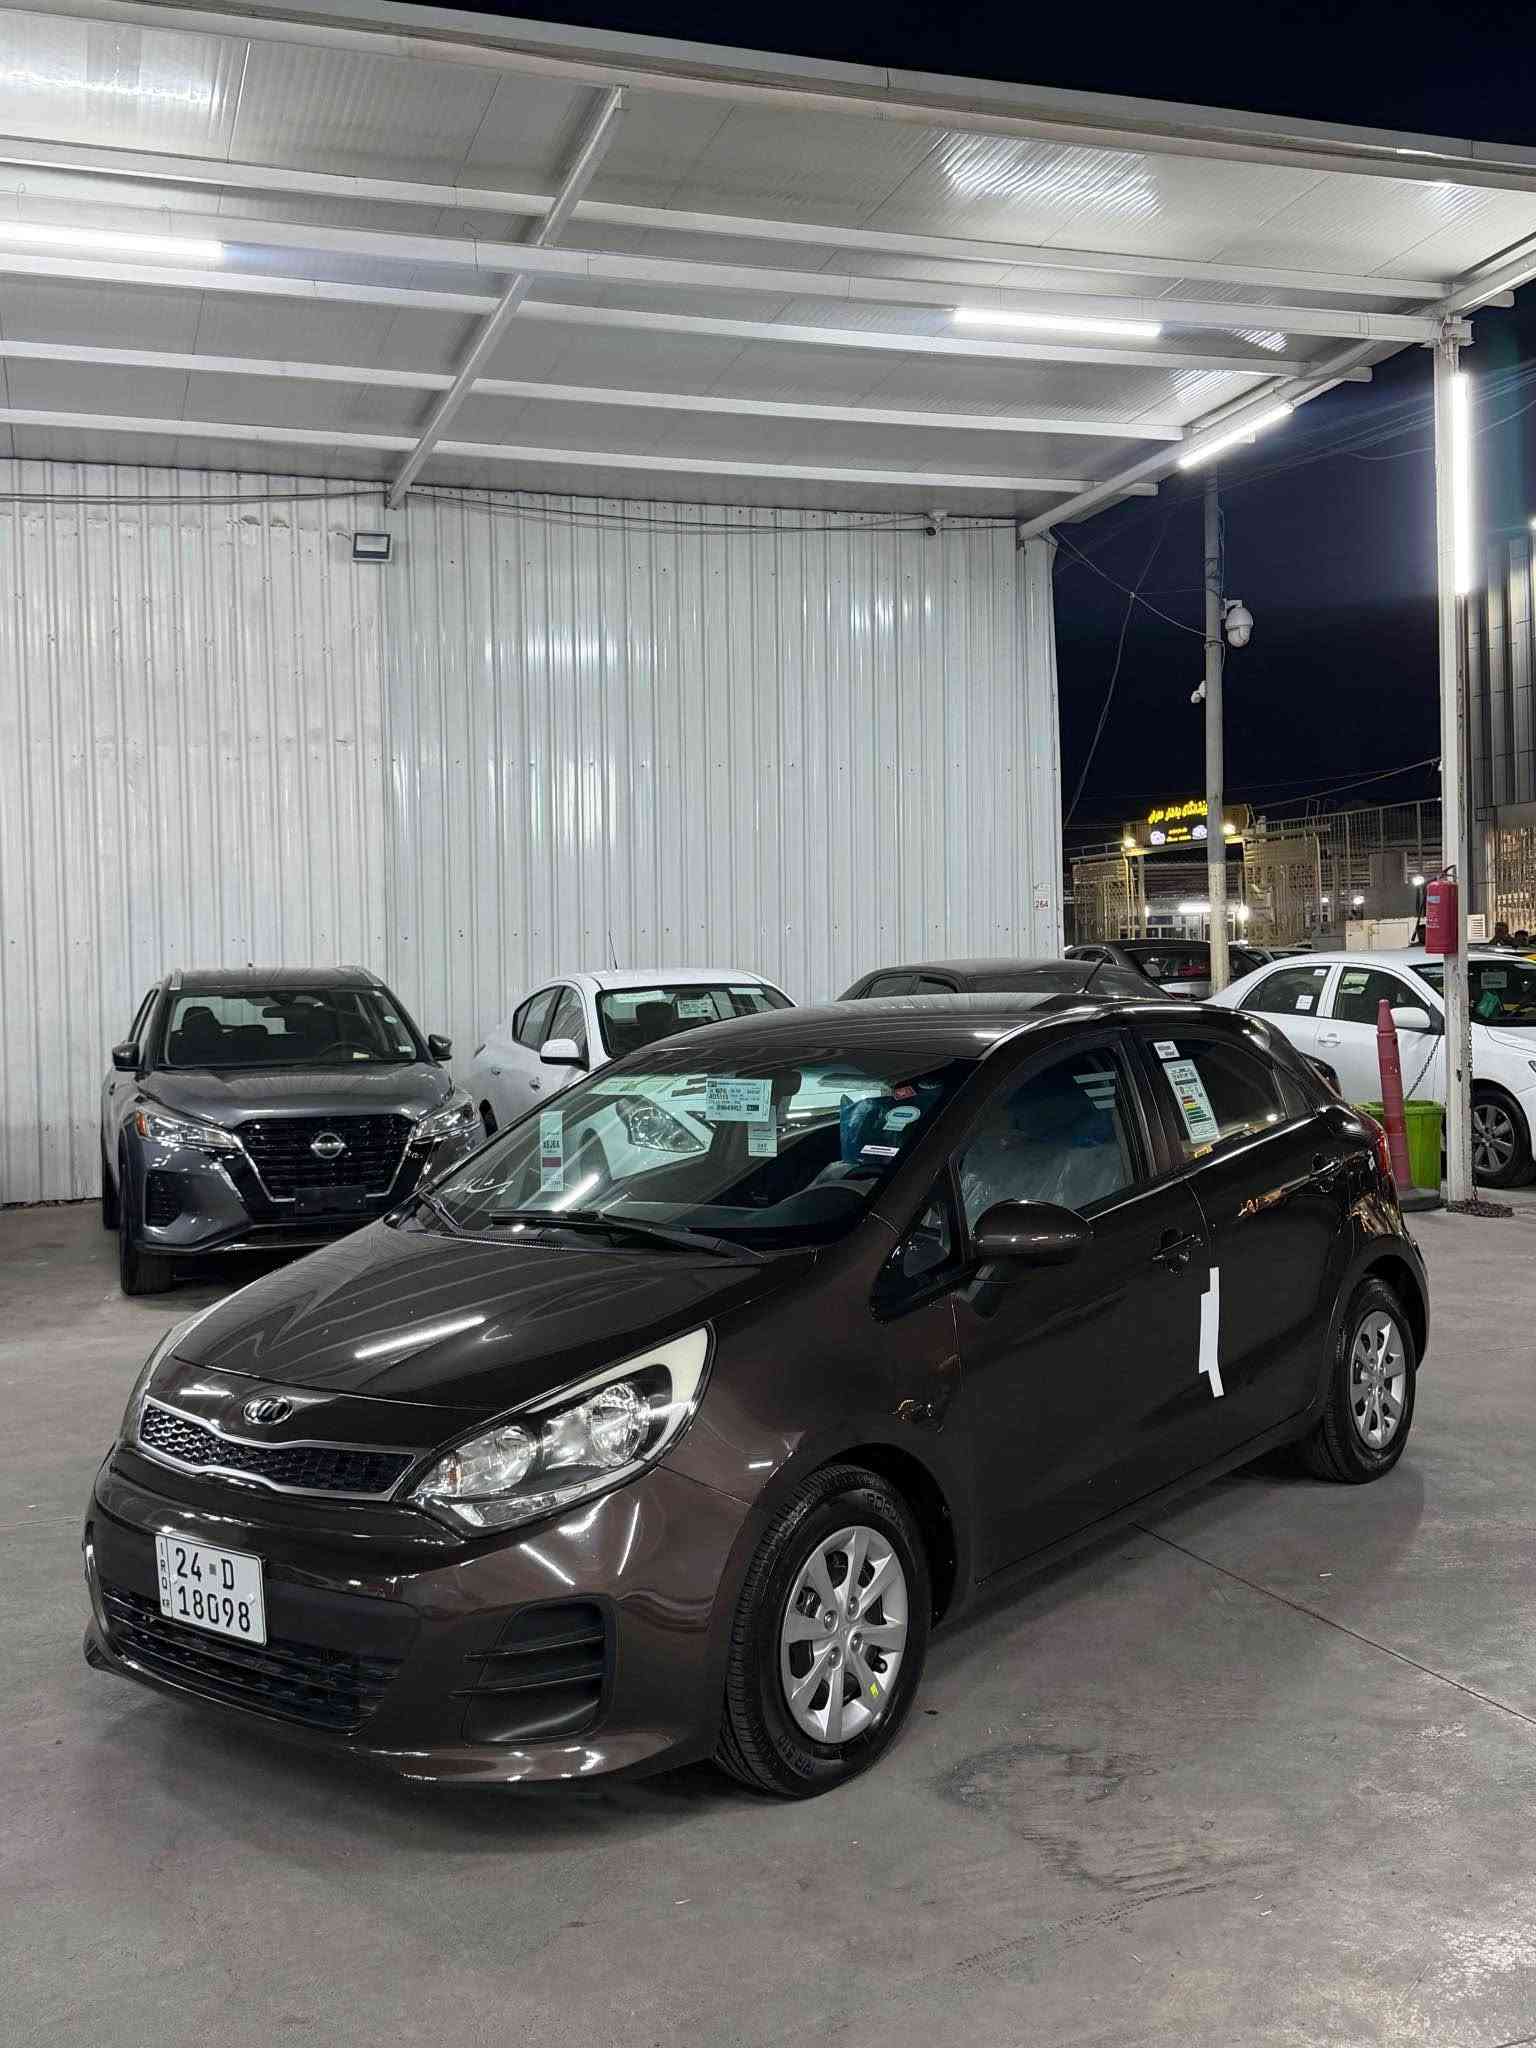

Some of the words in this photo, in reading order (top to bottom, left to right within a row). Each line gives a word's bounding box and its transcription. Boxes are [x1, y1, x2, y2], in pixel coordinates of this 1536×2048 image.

[160, 1541, 168, 1589] IRQ
[175, 1547, 202, 1582] 24
[221, 1558, 234, 1590] D
[178, 1585, 251, 1632] 18098
